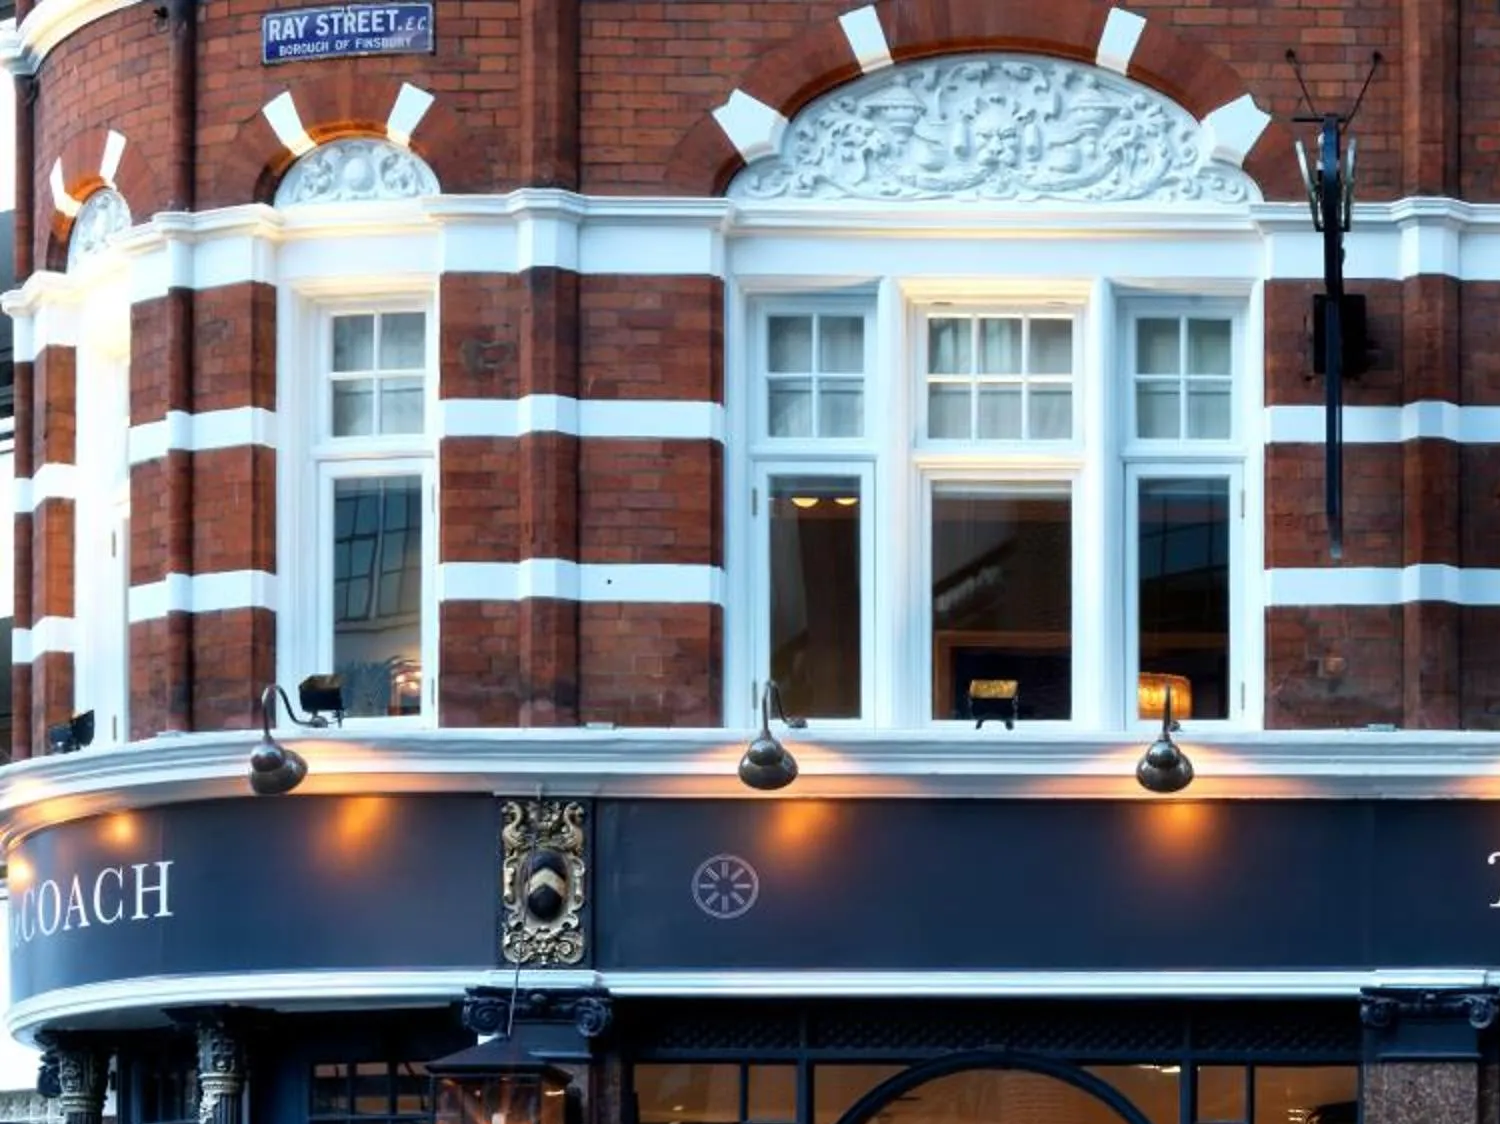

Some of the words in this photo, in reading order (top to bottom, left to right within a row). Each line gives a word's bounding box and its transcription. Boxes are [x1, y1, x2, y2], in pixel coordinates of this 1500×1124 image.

[269, 15, 309, 42] RAY
[279, 41, 329, 57] BOROUGH
[335, 38, 350, 51] OF
[355, 37, 412, 49] FINSBURY
[21, 860, 175, 942] COACH
